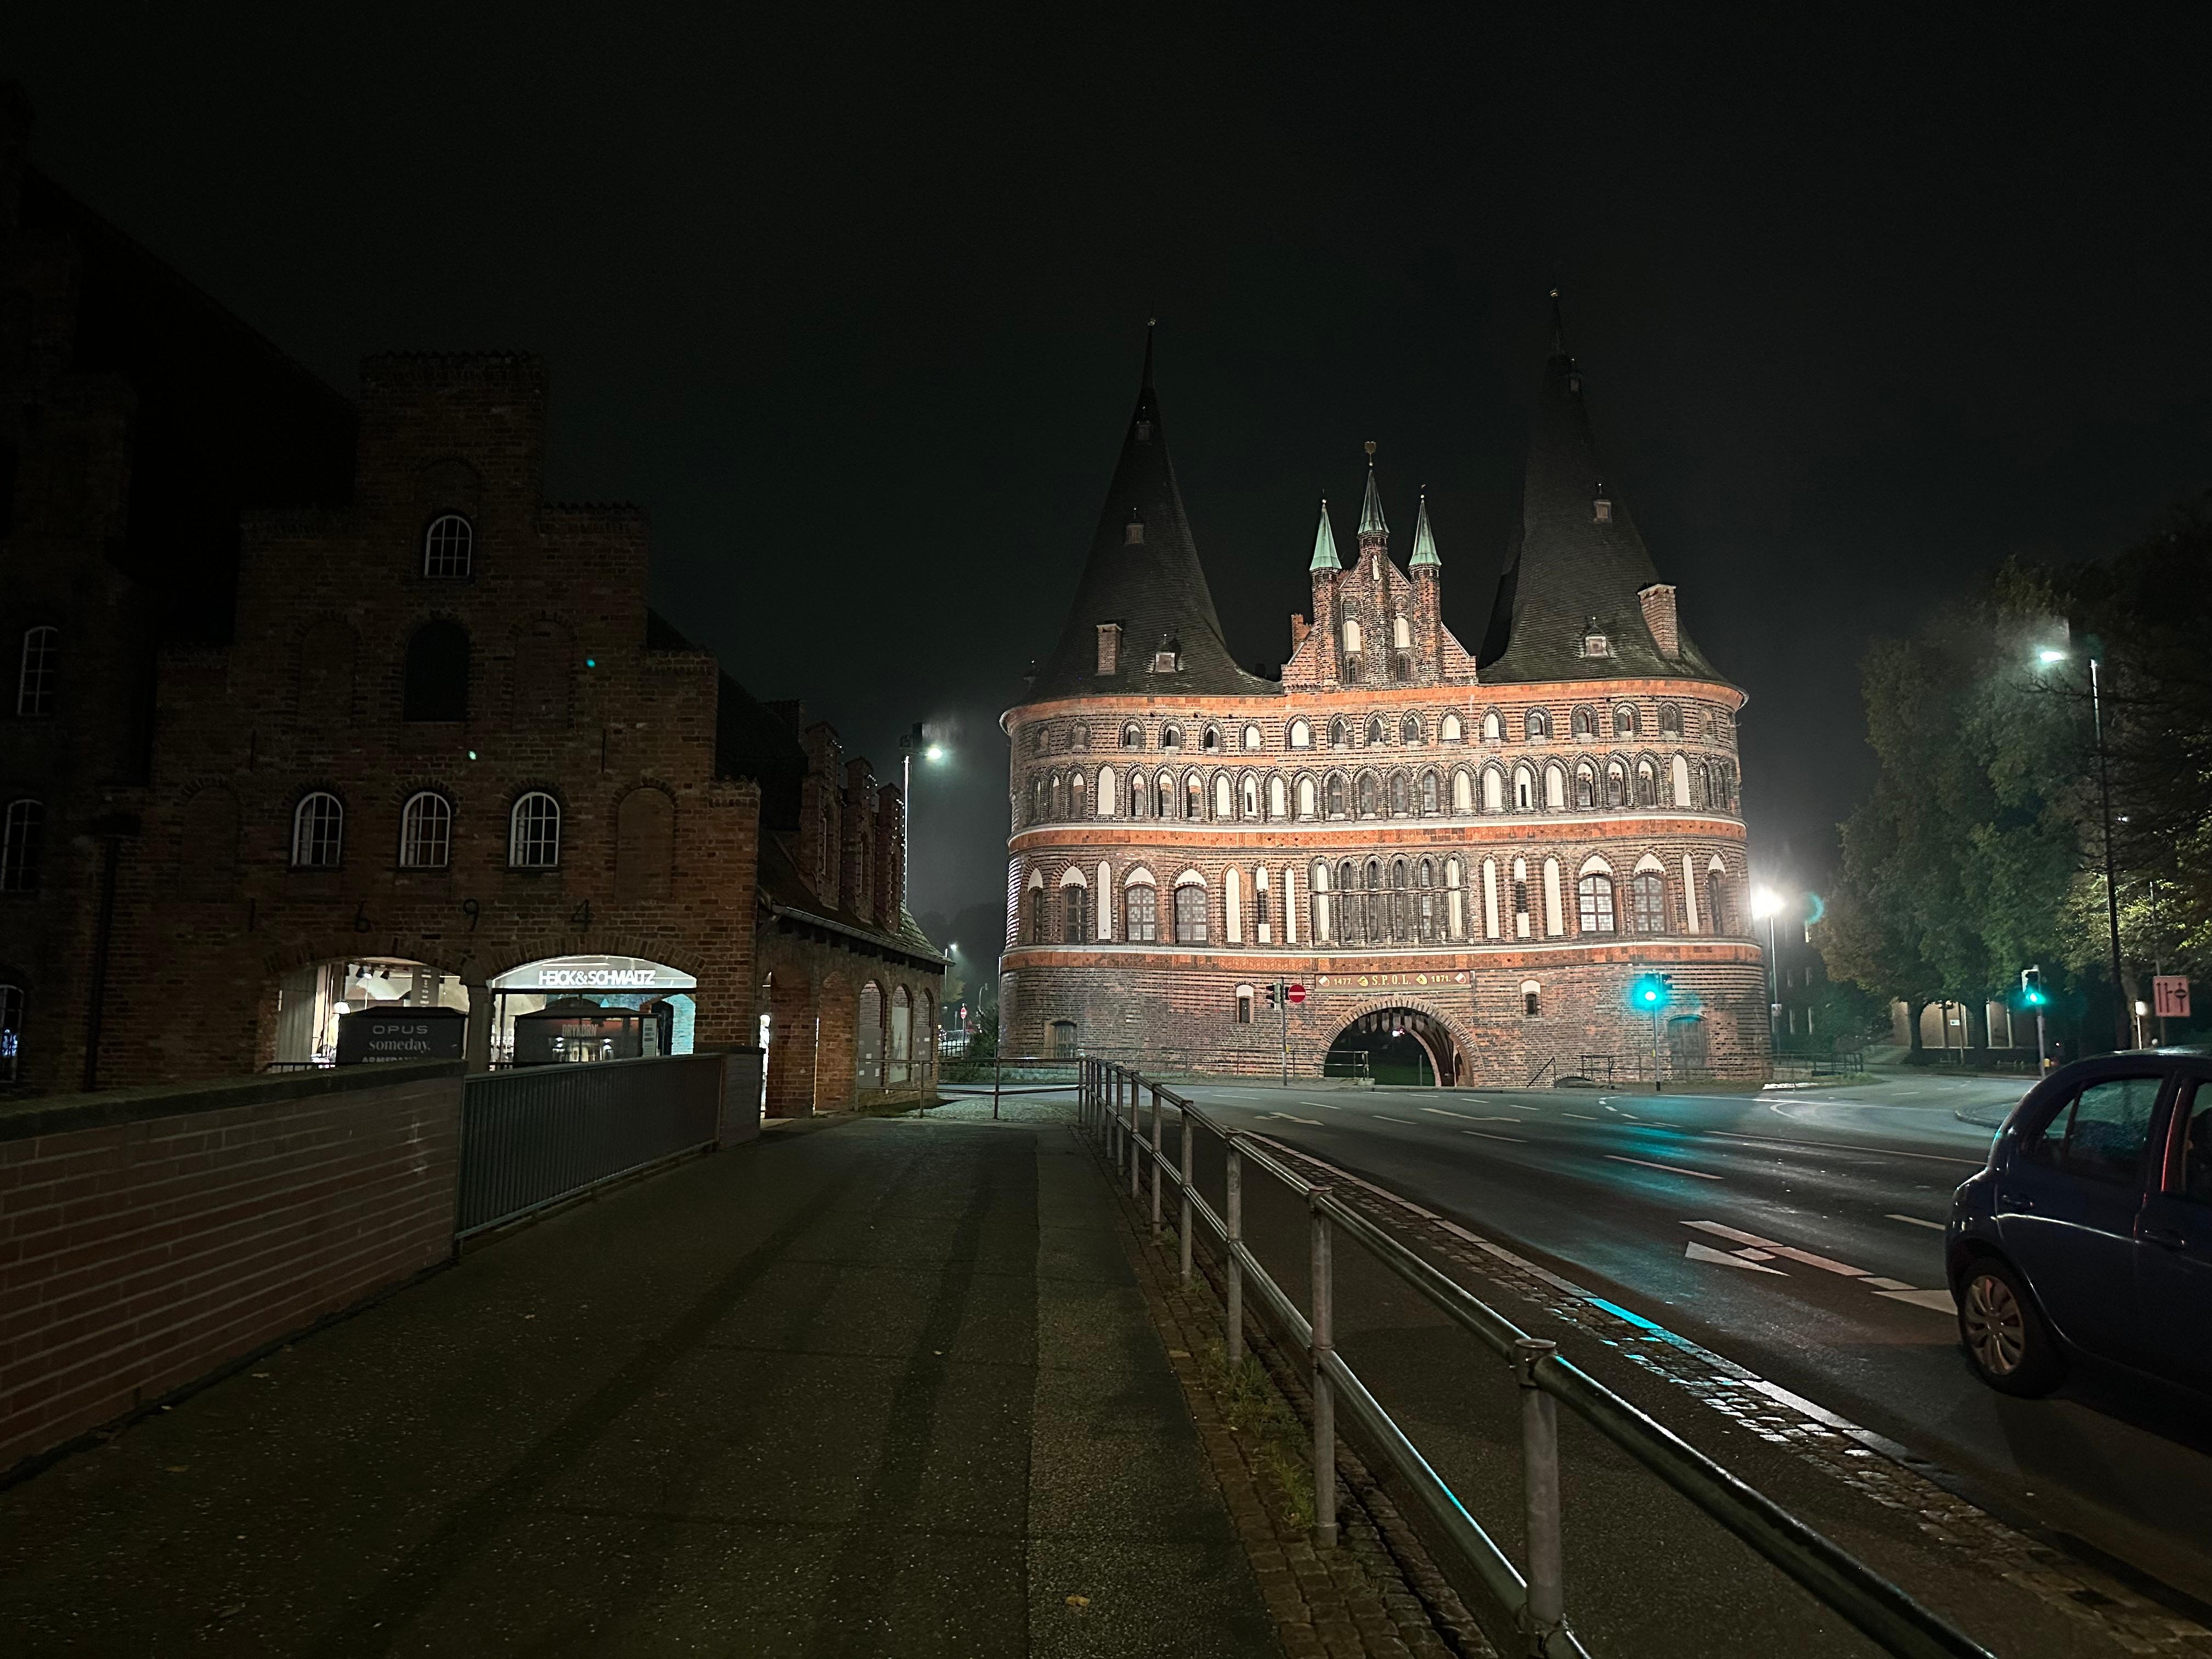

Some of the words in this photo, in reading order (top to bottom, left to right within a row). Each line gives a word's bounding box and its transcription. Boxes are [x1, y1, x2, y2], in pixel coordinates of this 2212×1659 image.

[538, 969, 656, 985] HEICK&SCHMALTZ
[1431, 974, 1451, 983] 1871.
[373, 1025, 429, 1035] OPUS
[368, 1038, 431, 1054] someday.
